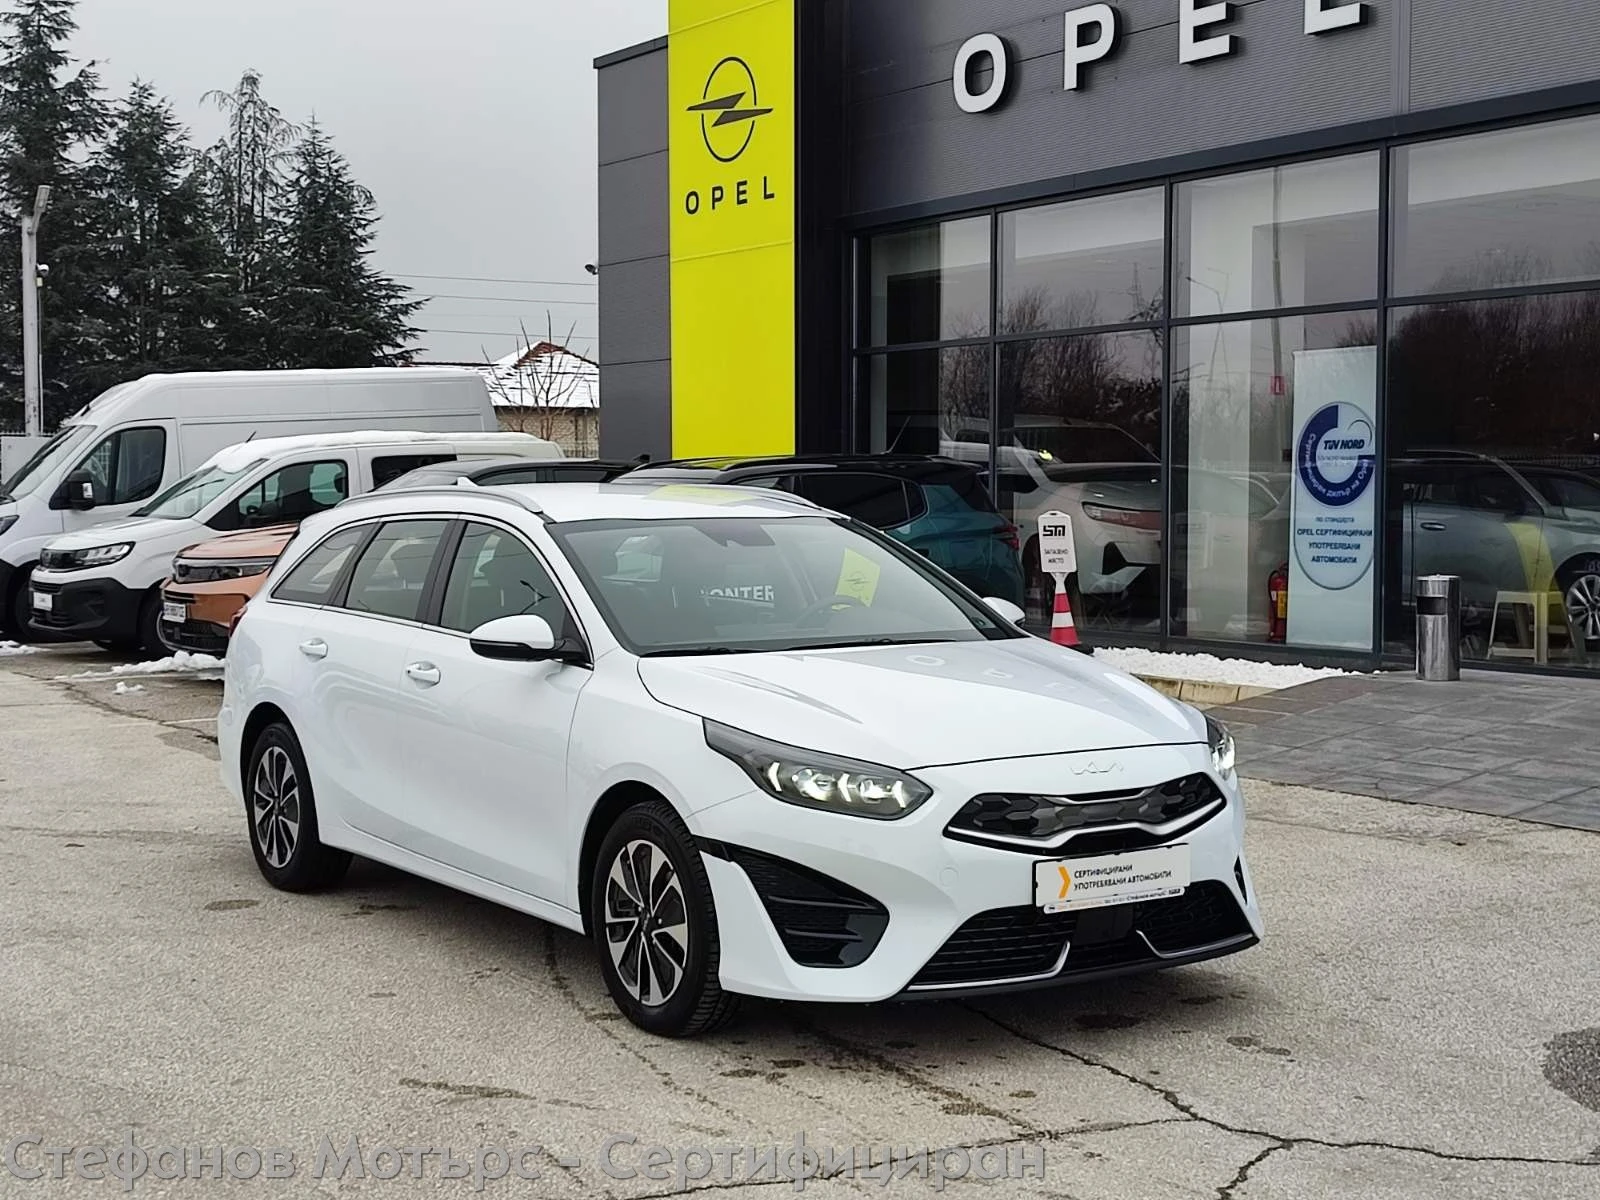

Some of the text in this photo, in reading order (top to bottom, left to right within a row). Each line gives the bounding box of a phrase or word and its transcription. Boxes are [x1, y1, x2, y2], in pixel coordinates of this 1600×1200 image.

[685, 176, 775, 215] OPEL
[1340, 439, 1365, 449] NORD
[1297, 528, 1314, 536] OPEL
[1073, 864, 1133, 879] СЕРТИФИЦИРАНИ
[1073, 870, 1172, 891] УПОТРЕБЯВАНИ АВТОМОБИЛИ
